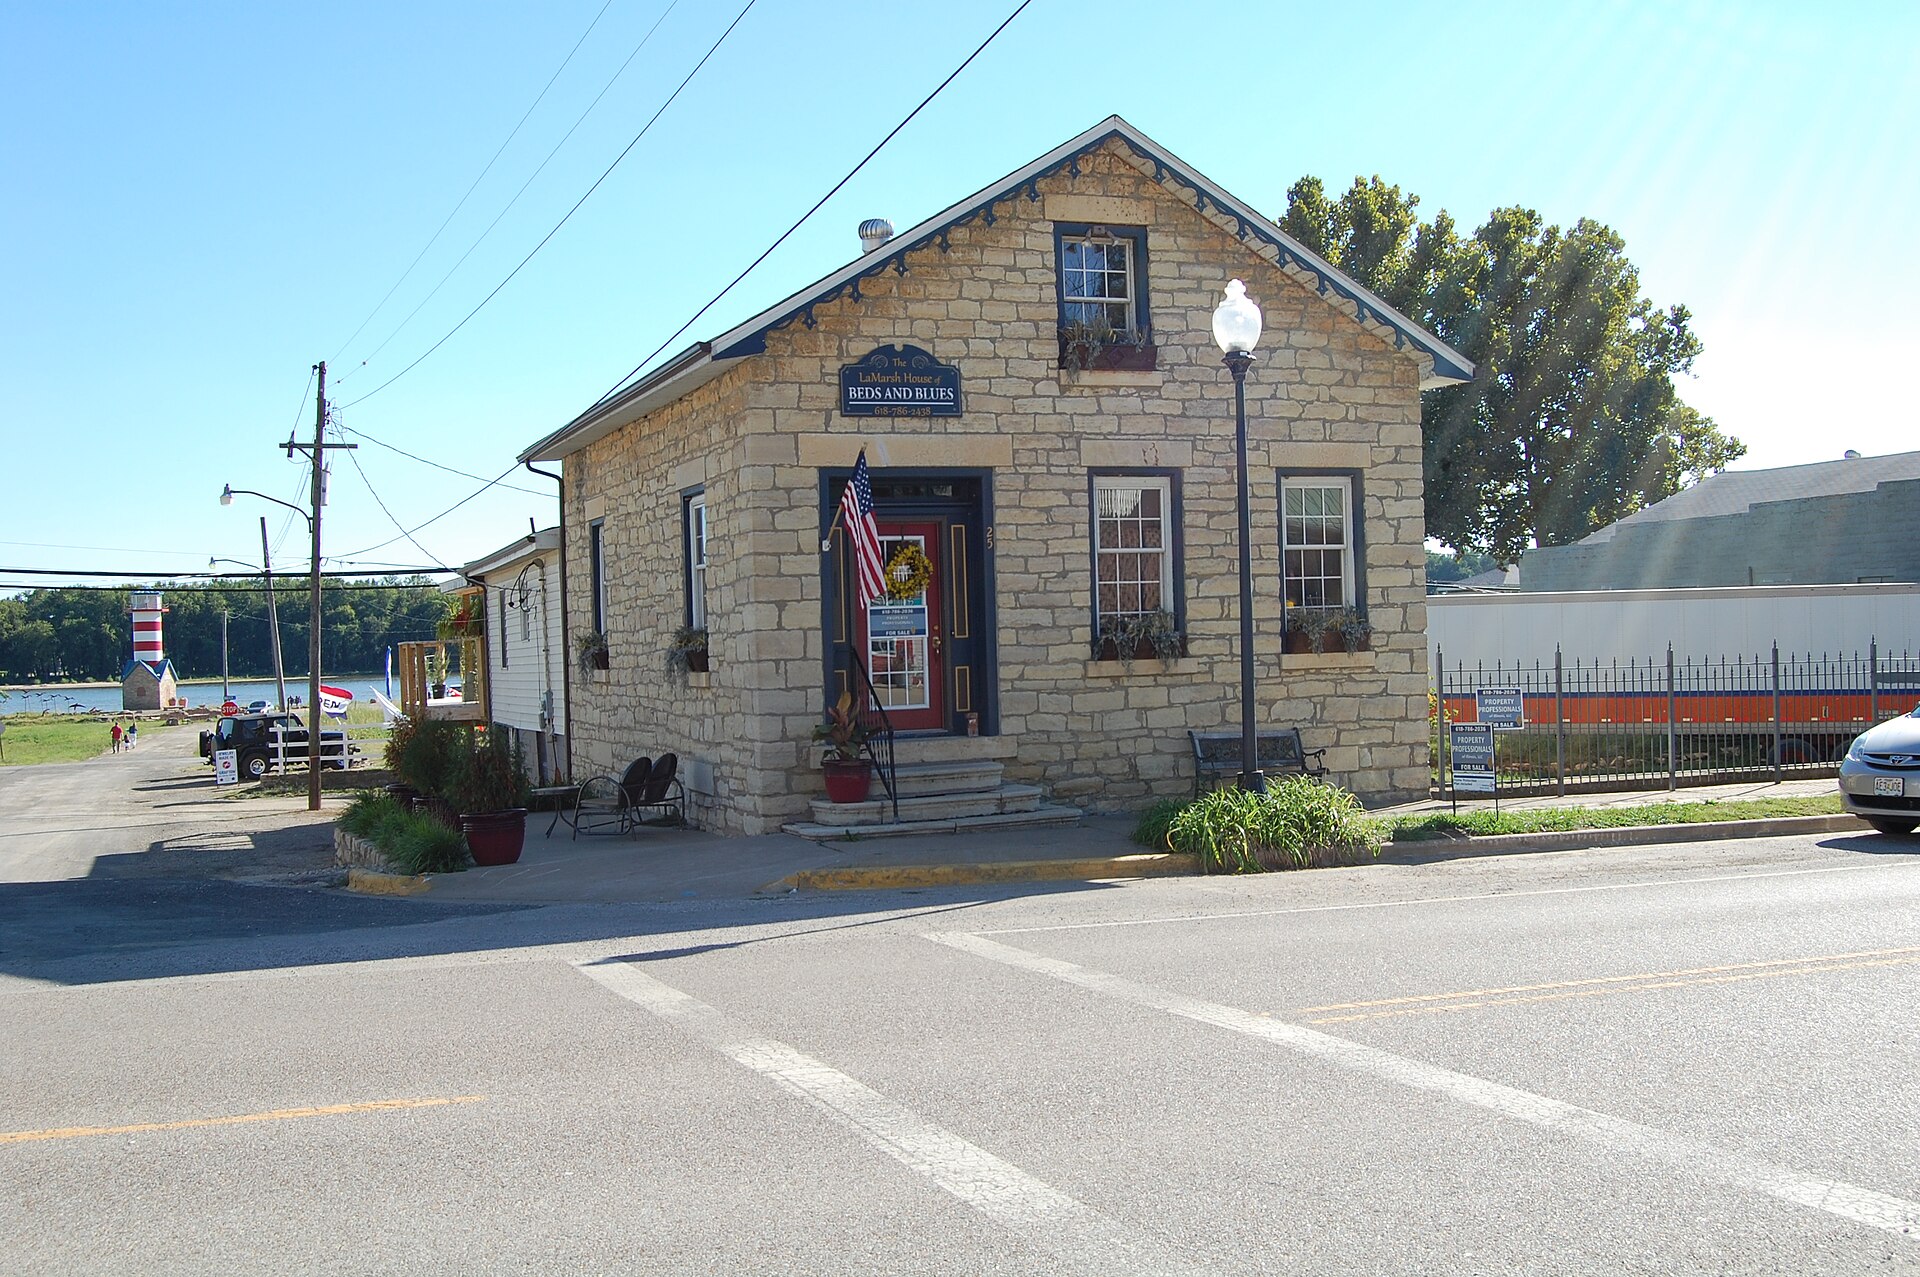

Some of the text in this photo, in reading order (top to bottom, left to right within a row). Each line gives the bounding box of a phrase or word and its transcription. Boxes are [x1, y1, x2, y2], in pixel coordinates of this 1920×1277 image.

[892, 357, 907, 367] The
[859, 372, 942, 385] LaMarsh House of
[848, 387, 954, 400] BEDS AND BLUES
[874, 406, 931, 416] 618-786-2438
[986, 526, 993, 550] 25
[320, 697, 340, 708] PEN
